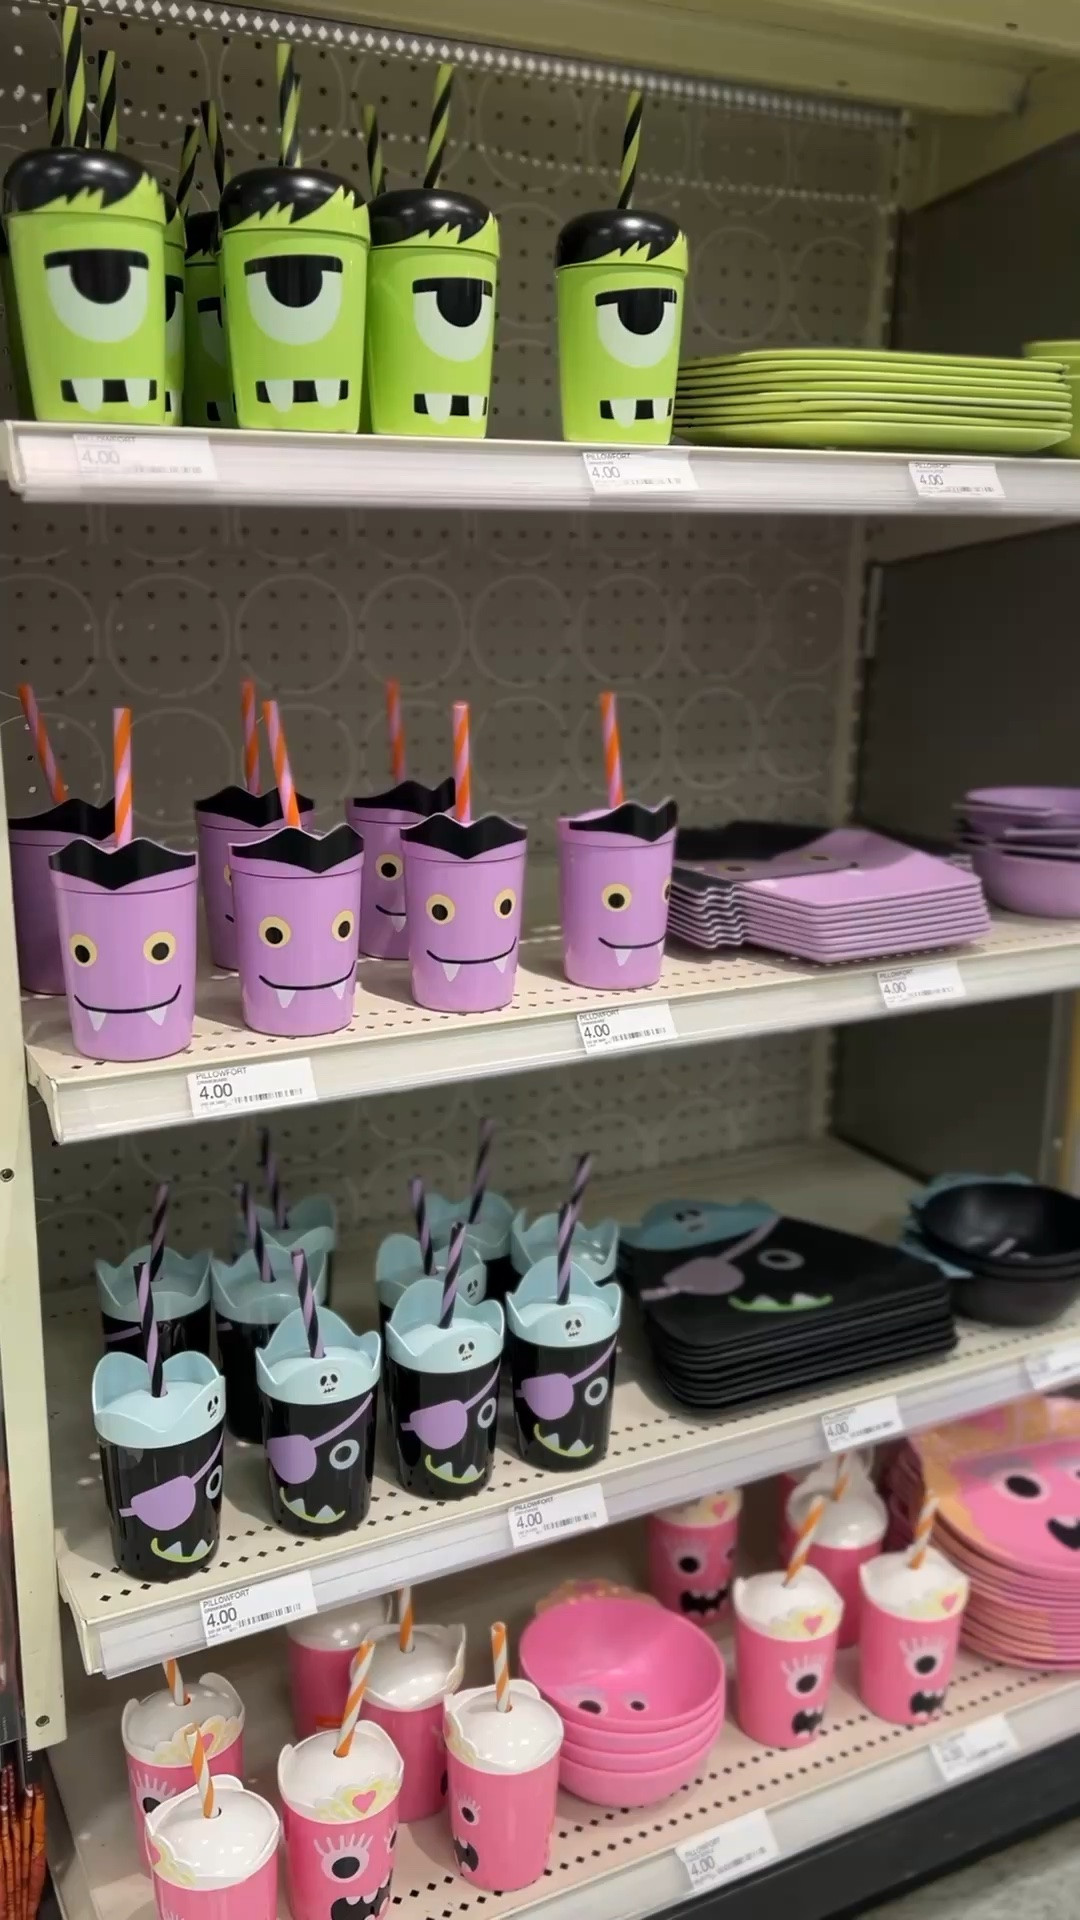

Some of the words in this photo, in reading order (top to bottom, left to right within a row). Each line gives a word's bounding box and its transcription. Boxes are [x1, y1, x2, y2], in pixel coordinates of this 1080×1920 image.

[81, 449, 120, 465] 4.00
[586, 452, 631, 460] PILLOWFORT
[592, 466, 620, 479] 4.00
[920, 474, 943, 486] 4.00
[884, 981, 907, 994] 4.00
[579, 1009, 620, 1021] PILLOWFORT
[583, 1023, 611, 1039] 4.00
[196, 1067, 248, 1080] PILLOWFORT
[199, 1083, 233, 1100] 4.00
[828, 1421, 850, 1437] 4.00
[514, 1496, 554, 1511] PILLOWFORT
[516, 1511, 543, 1529] 4.00
[203, 1588, 250, 1609] PILLOWFORT
[206, 1607, 237, 1628] 4.00
[691, 1855, 715, 1876] 4.00
